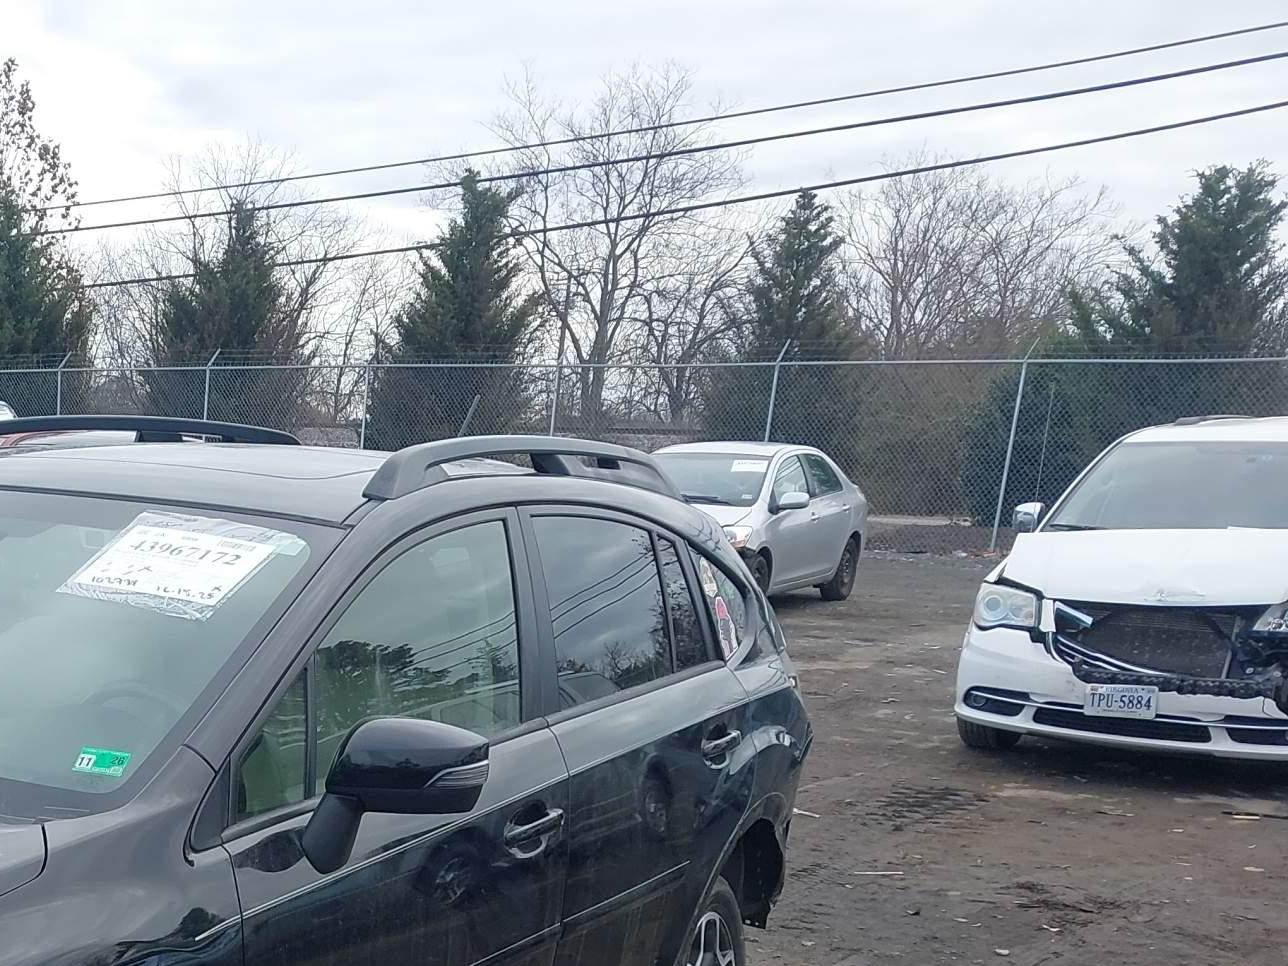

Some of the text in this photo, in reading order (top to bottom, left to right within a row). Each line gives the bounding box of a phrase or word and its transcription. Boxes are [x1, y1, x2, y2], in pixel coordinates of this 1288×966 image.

[130, 539, 242, 566] 43967172
[1090, 693, 1152, 710] TPU-5884
[78, 757, 92, 767] 11
[110, 756, 125, 765] 26
